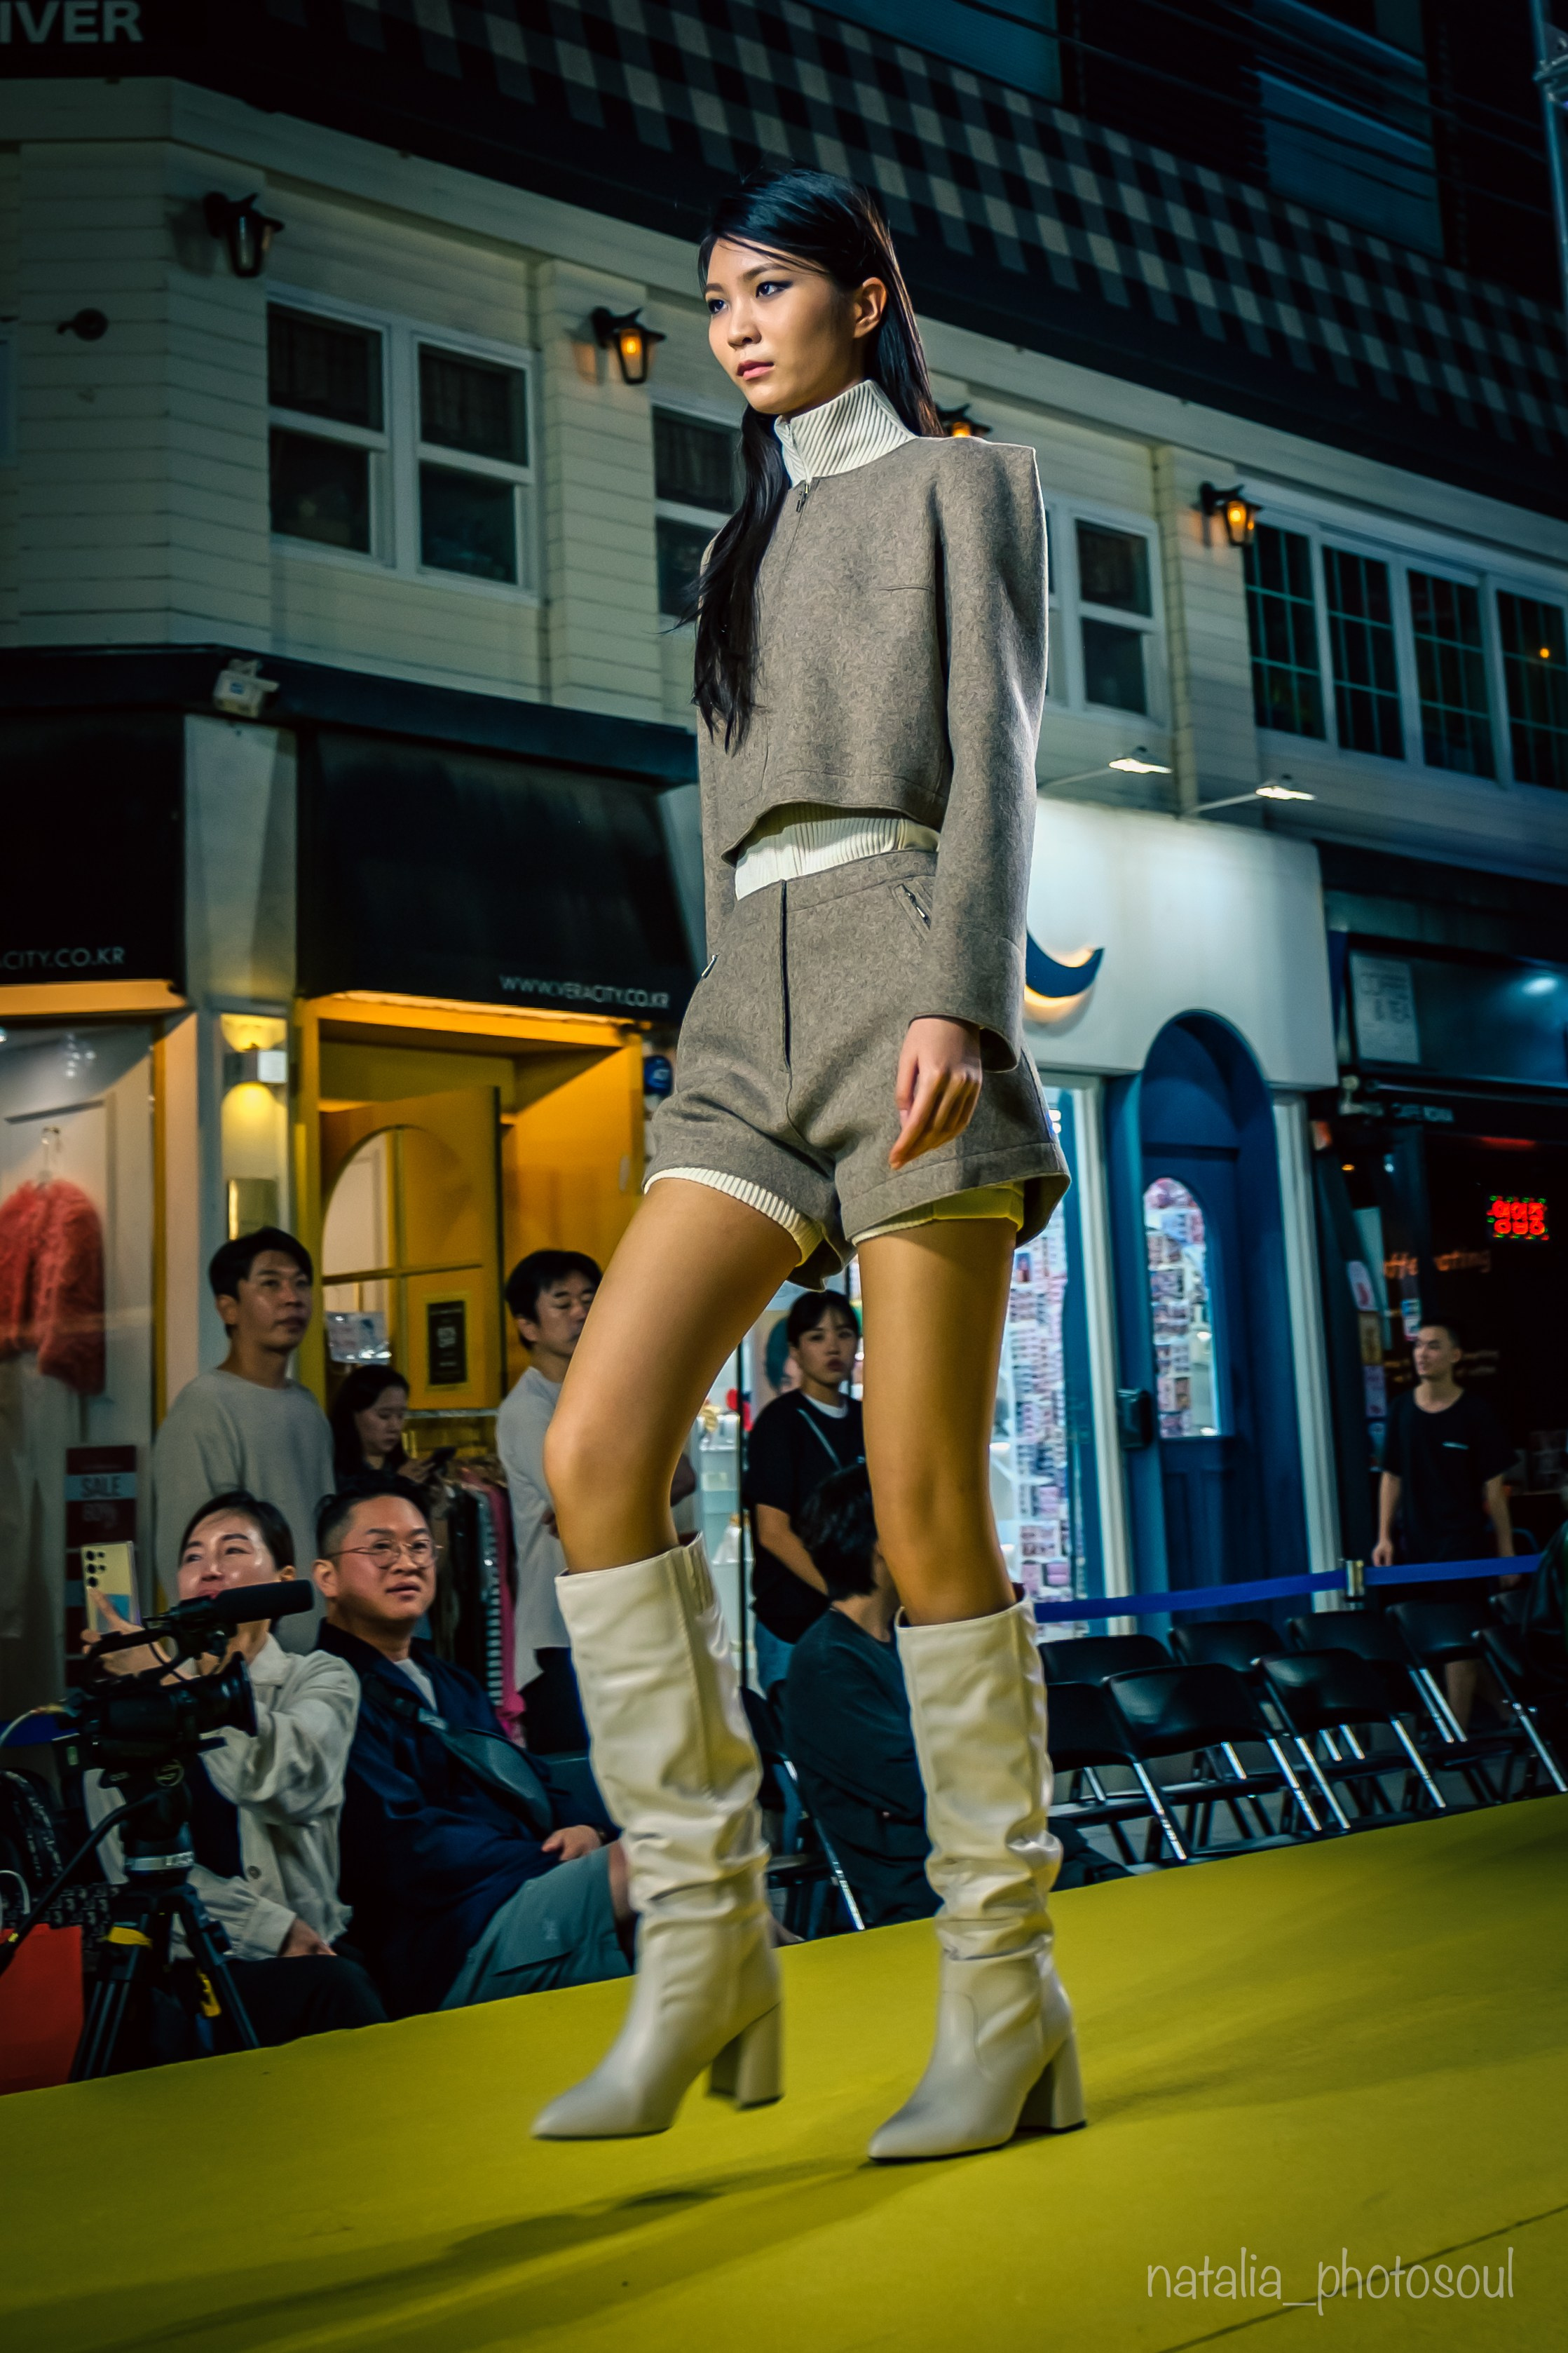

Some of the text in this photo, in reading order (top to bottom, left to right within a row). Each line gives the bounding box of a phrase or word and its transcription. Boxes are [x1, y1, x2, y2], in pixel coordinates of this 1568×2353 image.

[0, 1, 143, 43] IVER
[0, 947, 125, 970] CITY.CO.KR
[81, 1476, 121, 1498] SALE
